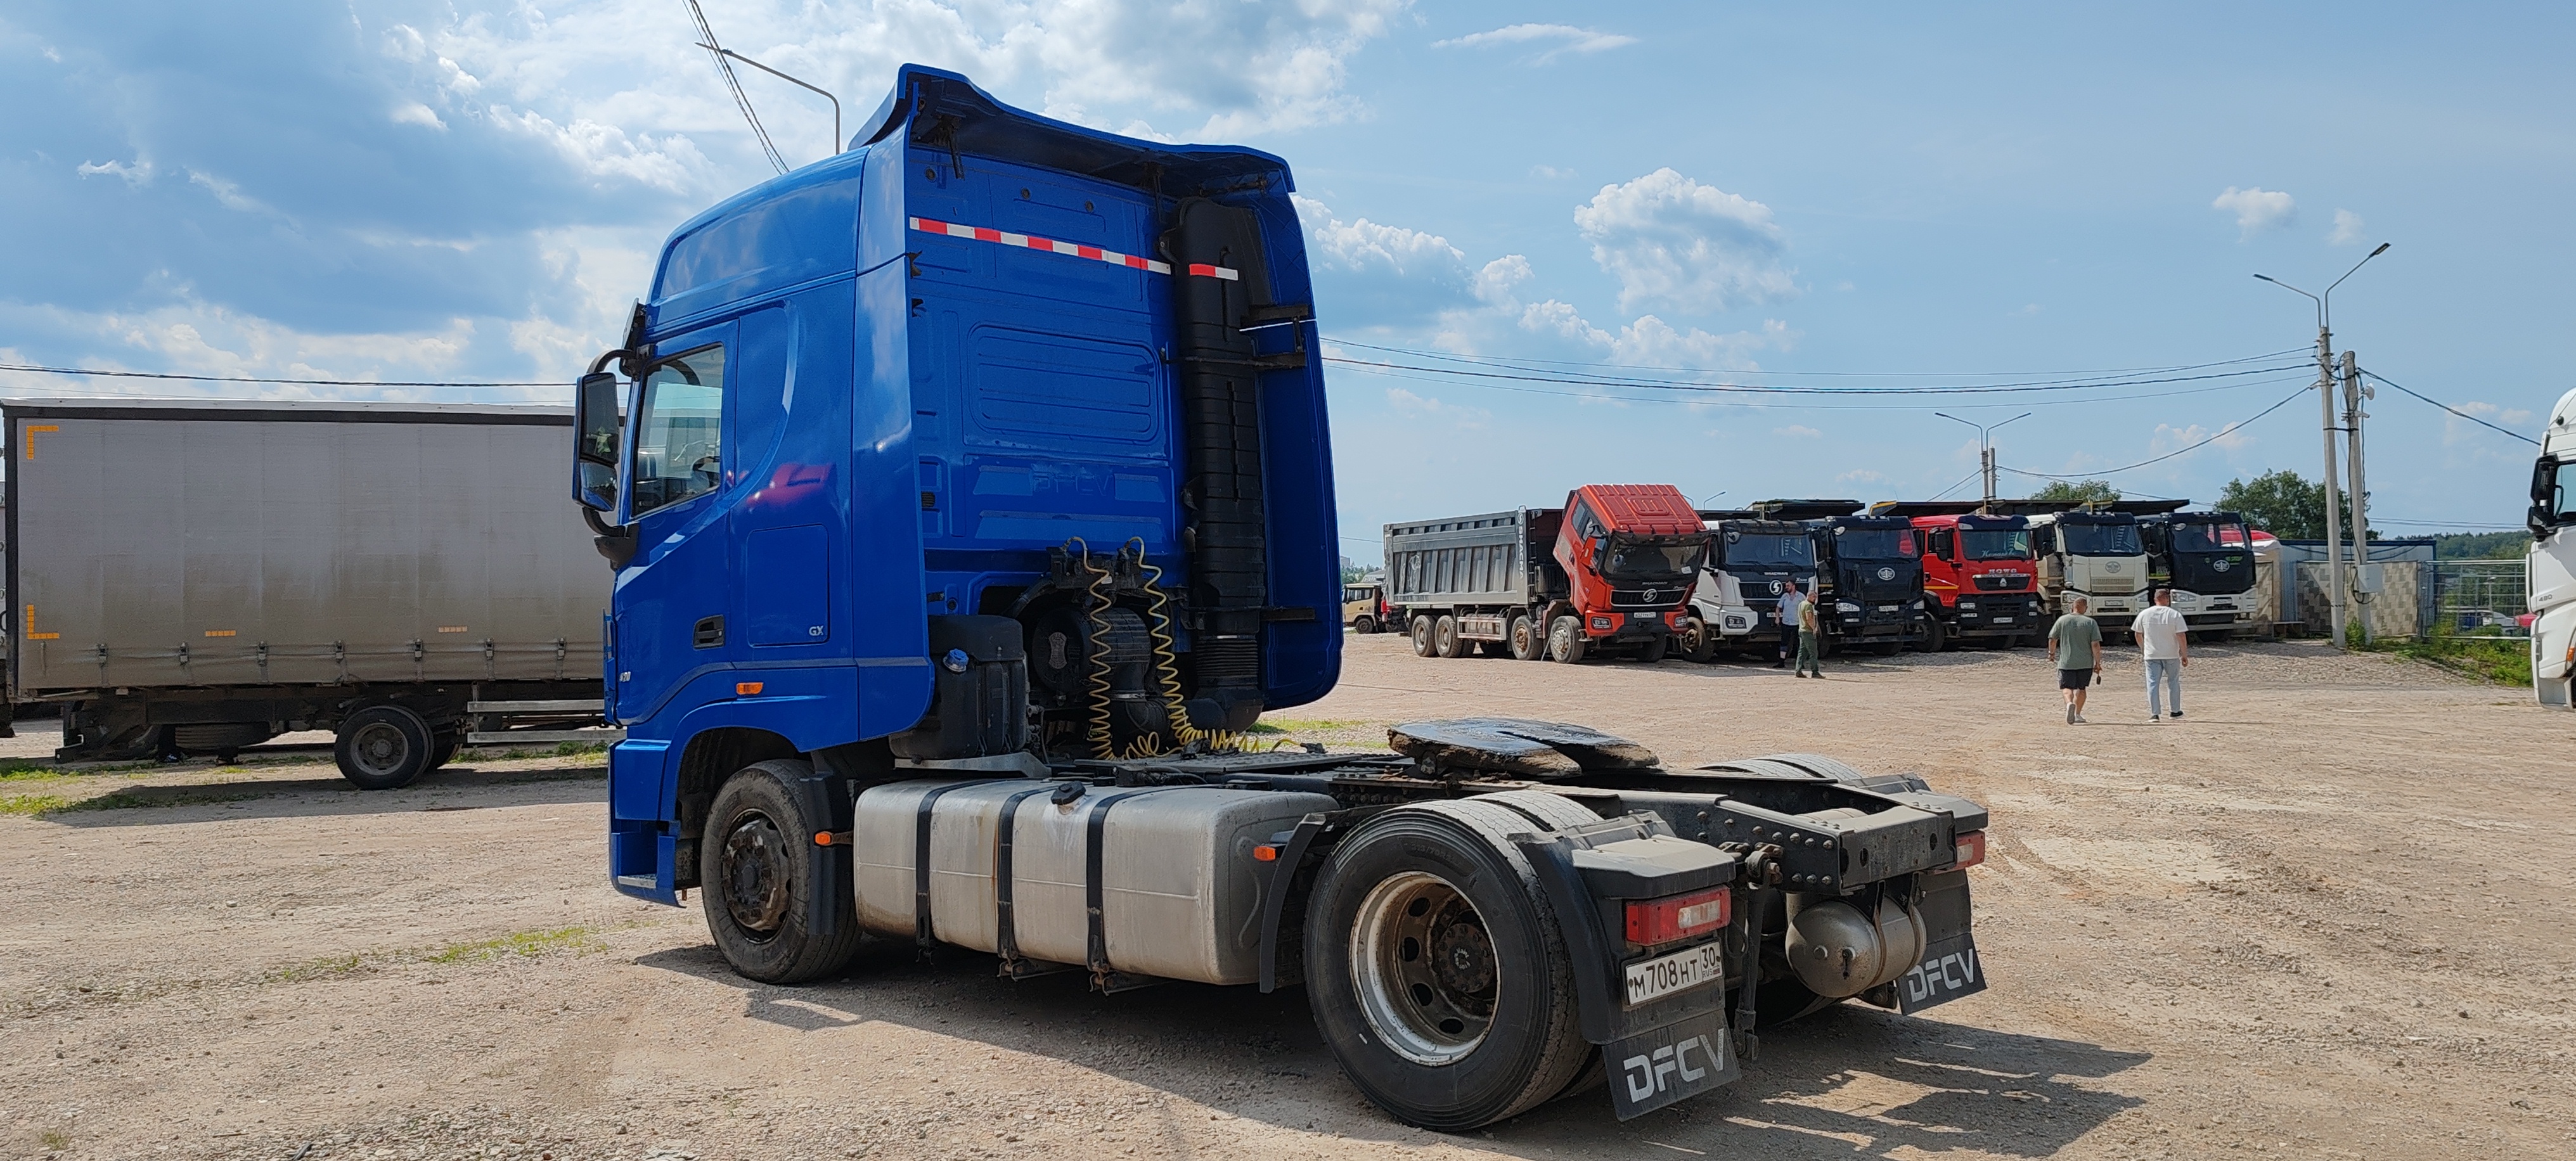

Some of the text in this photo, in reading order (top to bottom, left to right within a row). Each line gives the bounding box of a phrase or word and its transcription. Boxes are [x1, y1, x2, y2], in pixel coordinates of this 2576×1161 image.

[809, 625, 824, 636] GX
[1633, 946, 1716, 998] М708НТ 30
[1702, 969, 1713, 978] RUS
[1906, 948, 1974, 1003] DFCV
[1623, 1027, 1725, 1103] DFCV
